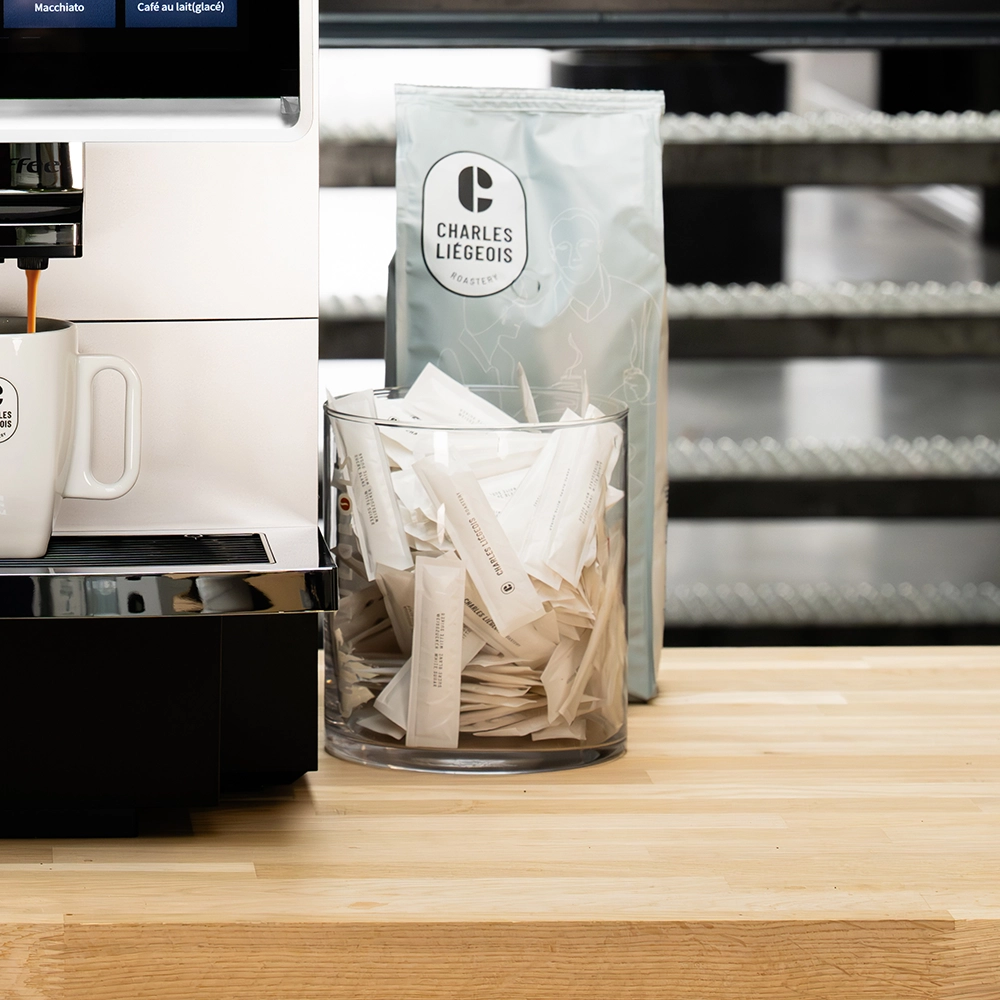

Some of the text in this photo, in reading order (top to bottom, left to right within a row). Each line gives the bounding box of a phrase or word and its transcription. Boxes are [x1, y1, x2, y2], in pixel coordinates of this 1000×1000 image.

[34, 1, 85, 13] Macchiato
[137, 0, 225, 15] Café au lait(glacé)
[436, 222, 513, 243] CHARLES
[436, 242, 513, 263] LIÉGEOIS
[449, 271, 499, 286] ROASTERY
[484, 546, 504, 577] CHARLES
[464, 598, 485, 618] CHARLES
